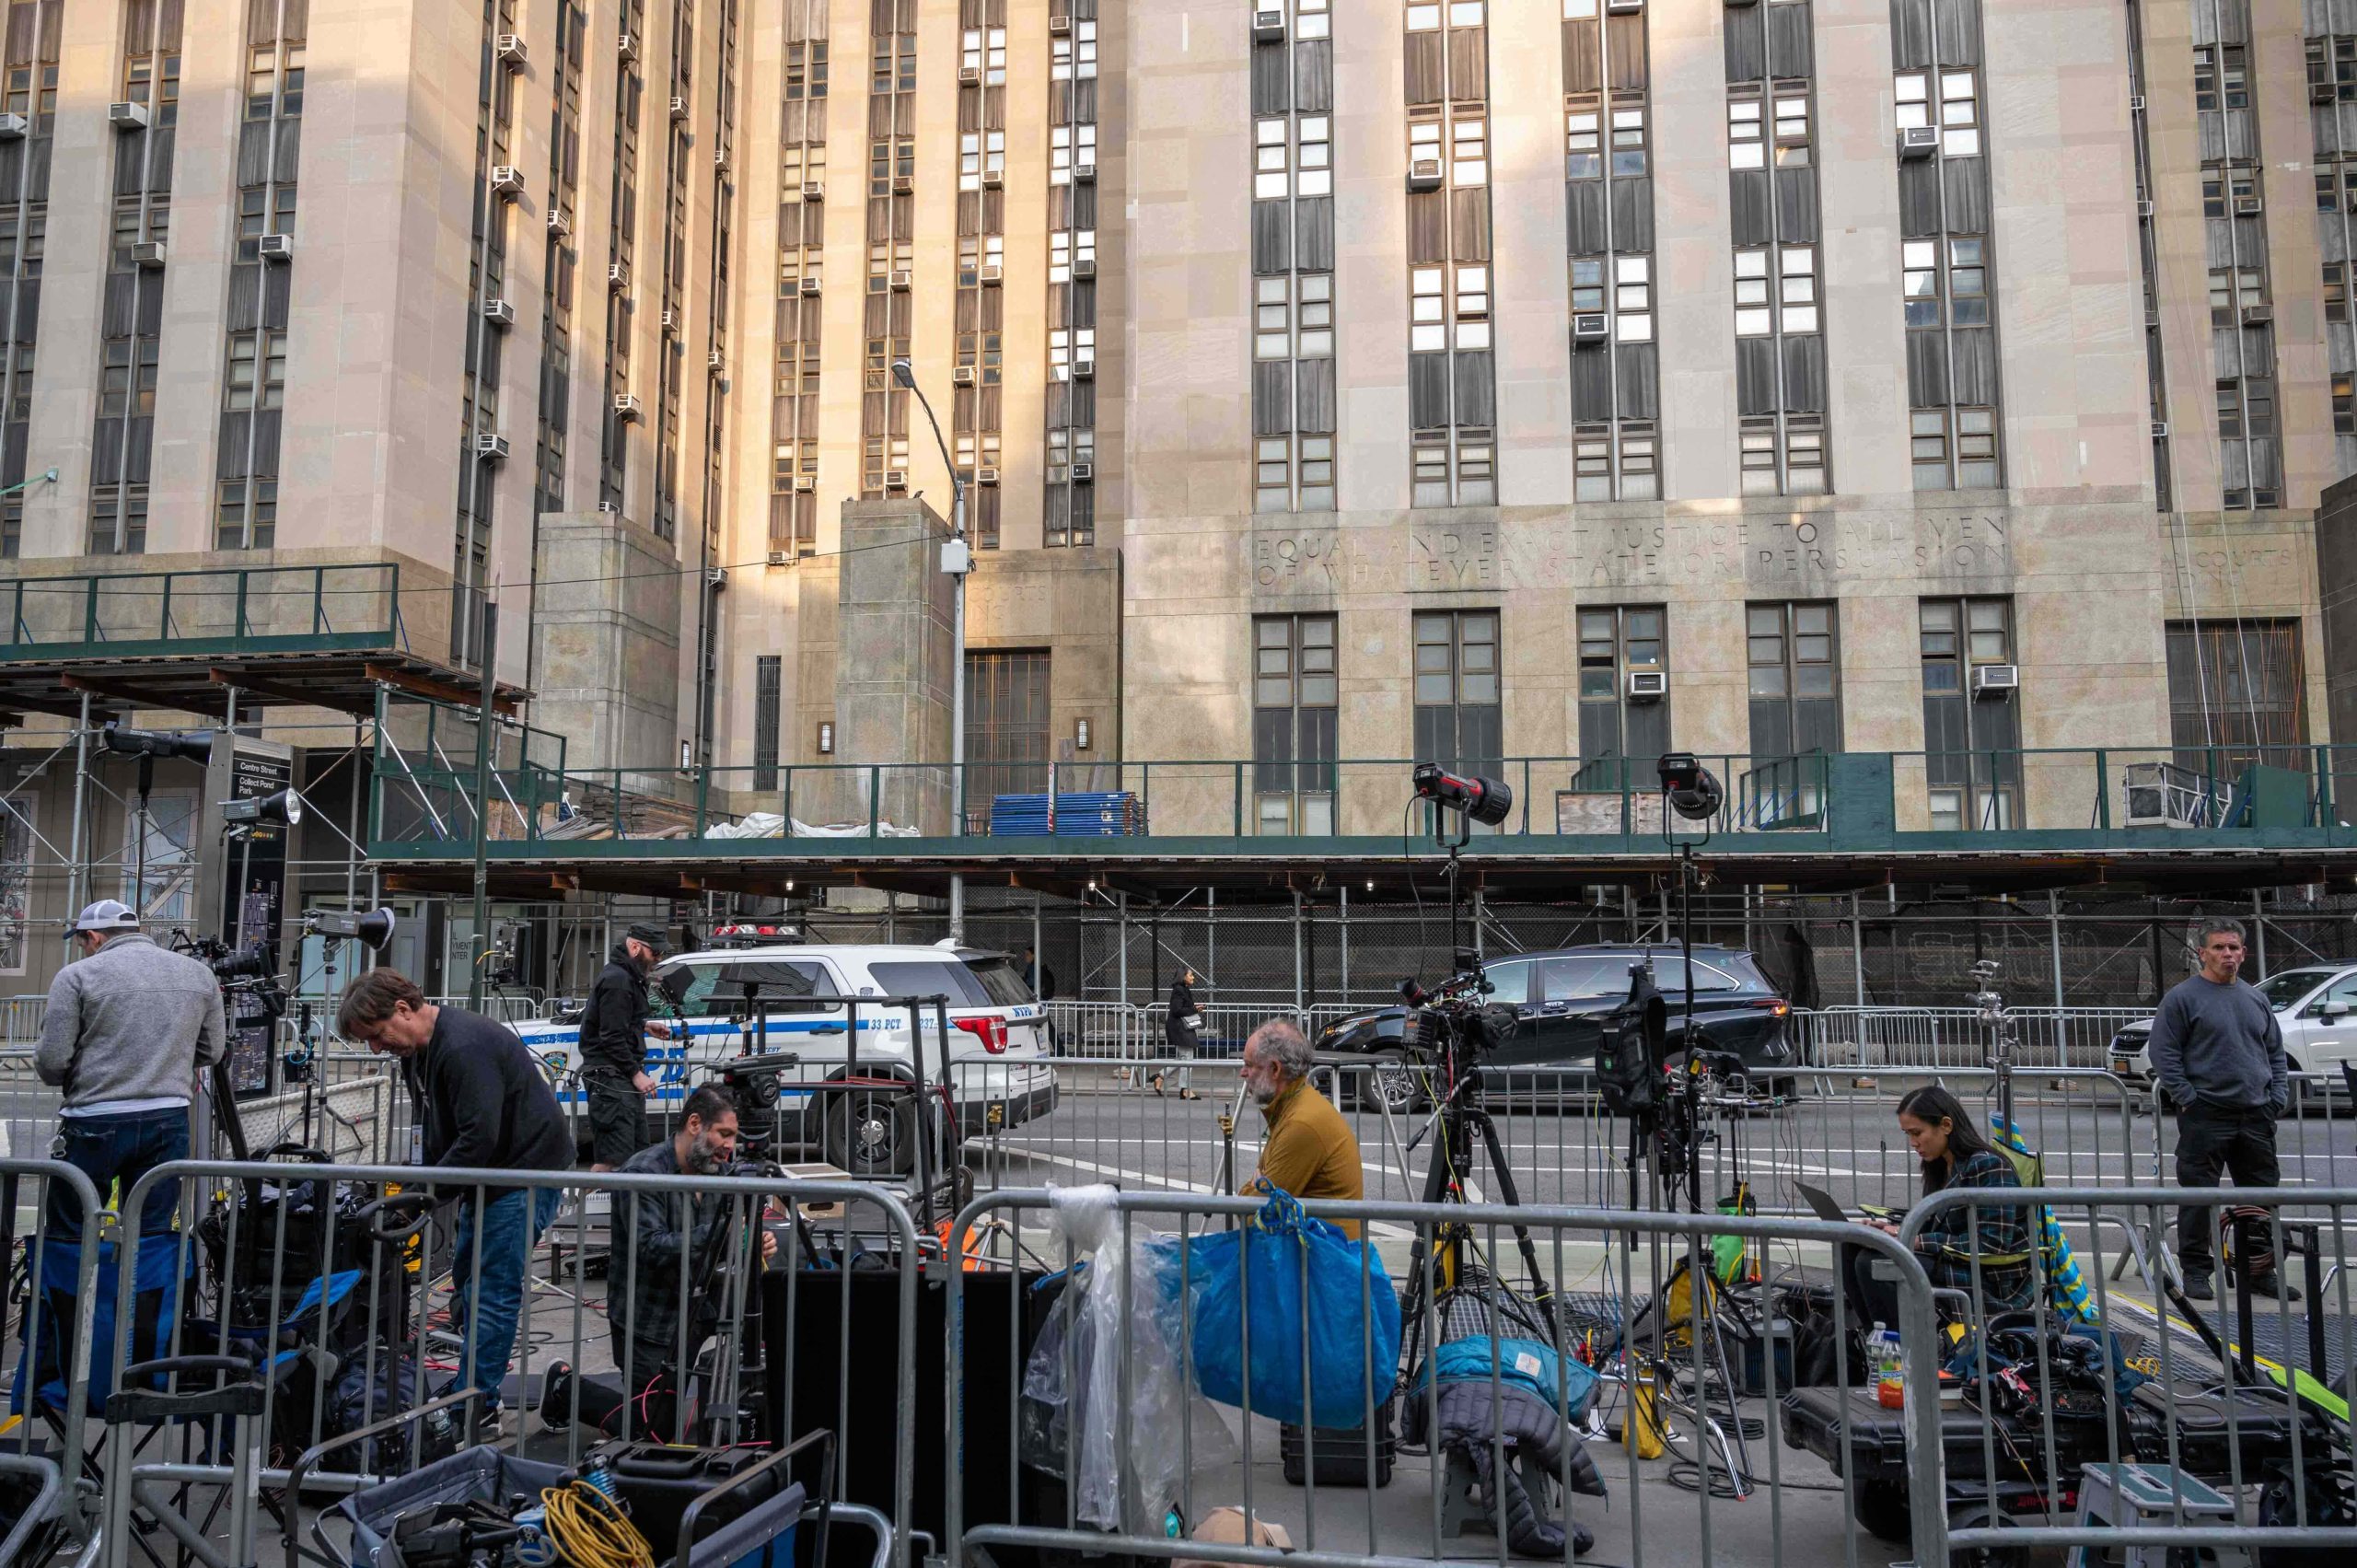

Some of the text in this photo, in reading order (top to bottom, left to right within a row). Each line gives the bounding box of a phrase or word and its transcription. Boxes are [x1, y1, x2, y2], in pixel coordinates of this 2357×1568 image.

[1258, 517, 2005, 563] EQUAL AND EXACT JUSTICE TO ALL MEN
[1258, 543, 2007, 587] OF WHATEVER STATE OR PERSUASION
[239, 761, 278, 775] Centre Street
[239, 776, 274, 789] Collect Pond
[238, 786, 253, 795] Park
[1012, 1006, 1033, 1016] NYPD
[871, 1019, 881, 1029] 33
[885, 1018, 901, 1029] PCT
